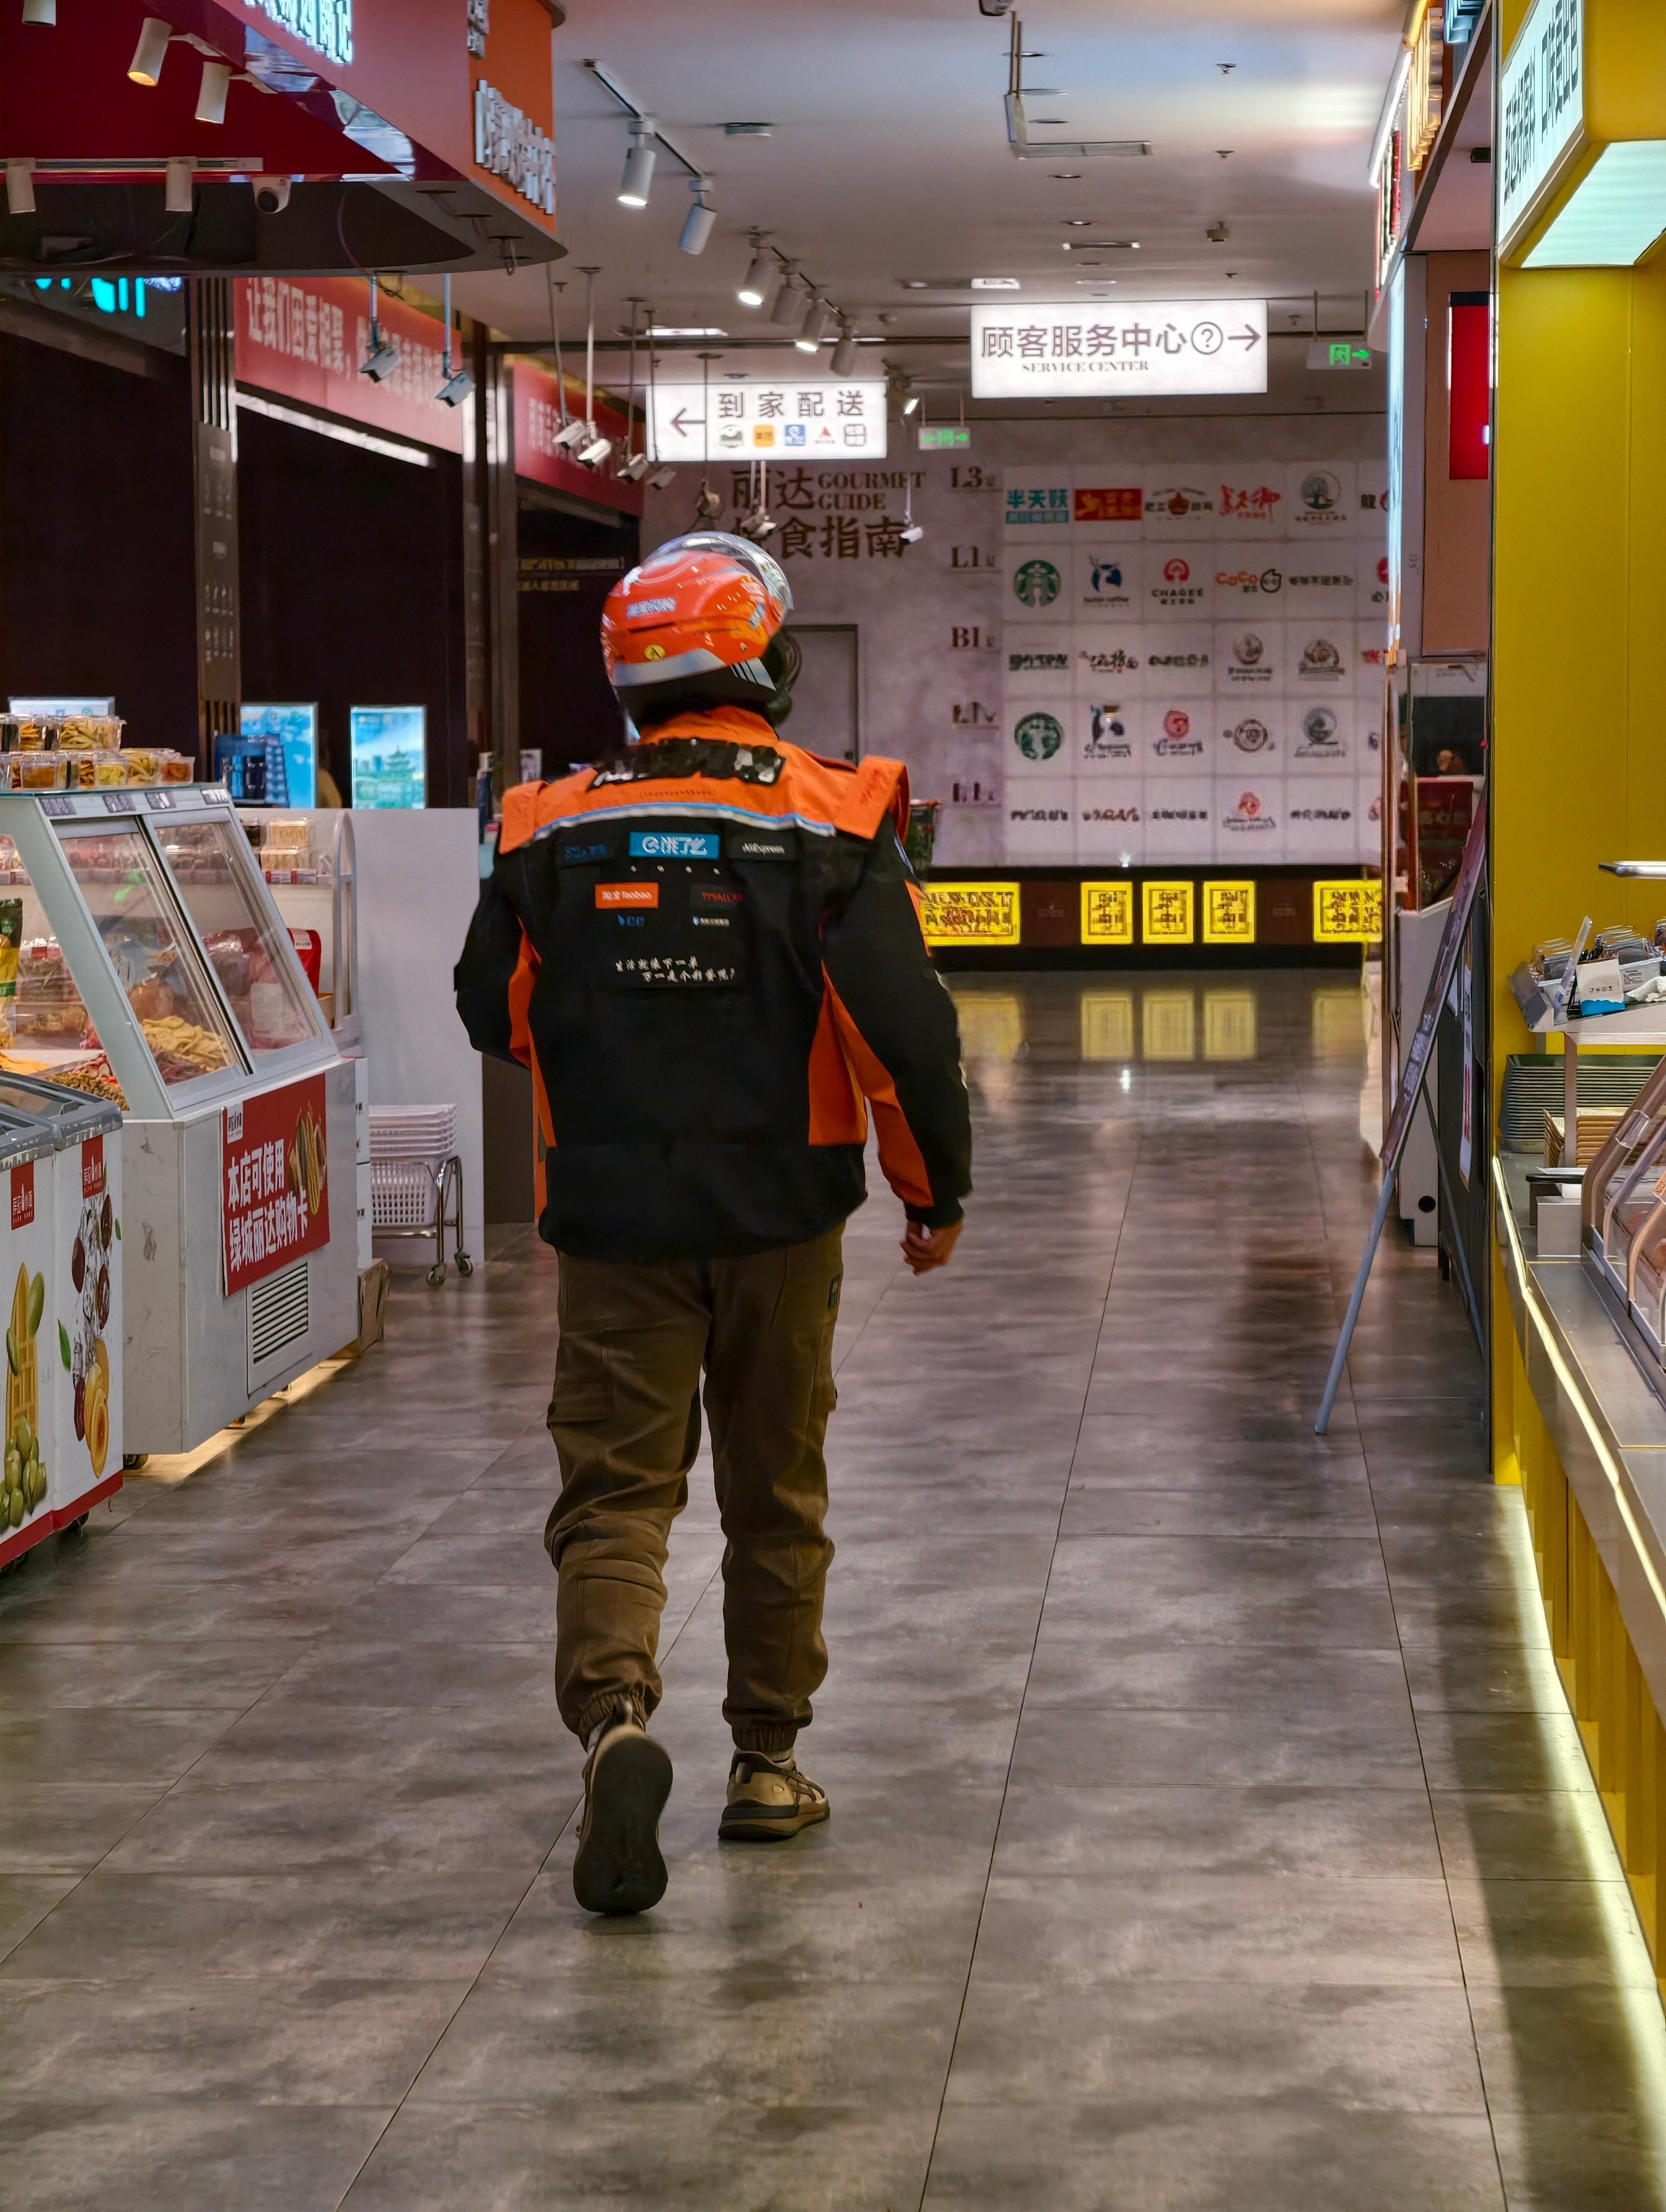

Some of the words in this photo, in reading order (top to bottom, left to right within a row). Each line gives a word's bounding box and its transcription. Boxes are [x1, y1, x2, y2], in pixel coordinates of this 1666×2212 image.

[981, 323, 1188, 358] 顾客服务中心
[1022, 362, 1086, 373] SERVICE
[1090, 361, 1149, 372] CENTER
[717, 390, 864, 419] 到家配送
[731, 467, 815, 510] 丽达
[818, 472, 926, 488] GOURMET
[950, 466, 983, 488] L3
[818, 493, 886, 511] GUIDE
[731, 516, 907, 560] 食指南
[228, 1139, 285, 1212] 本店可使用
[229, 1186, 309, 1273] 绿城丽达购物卡
